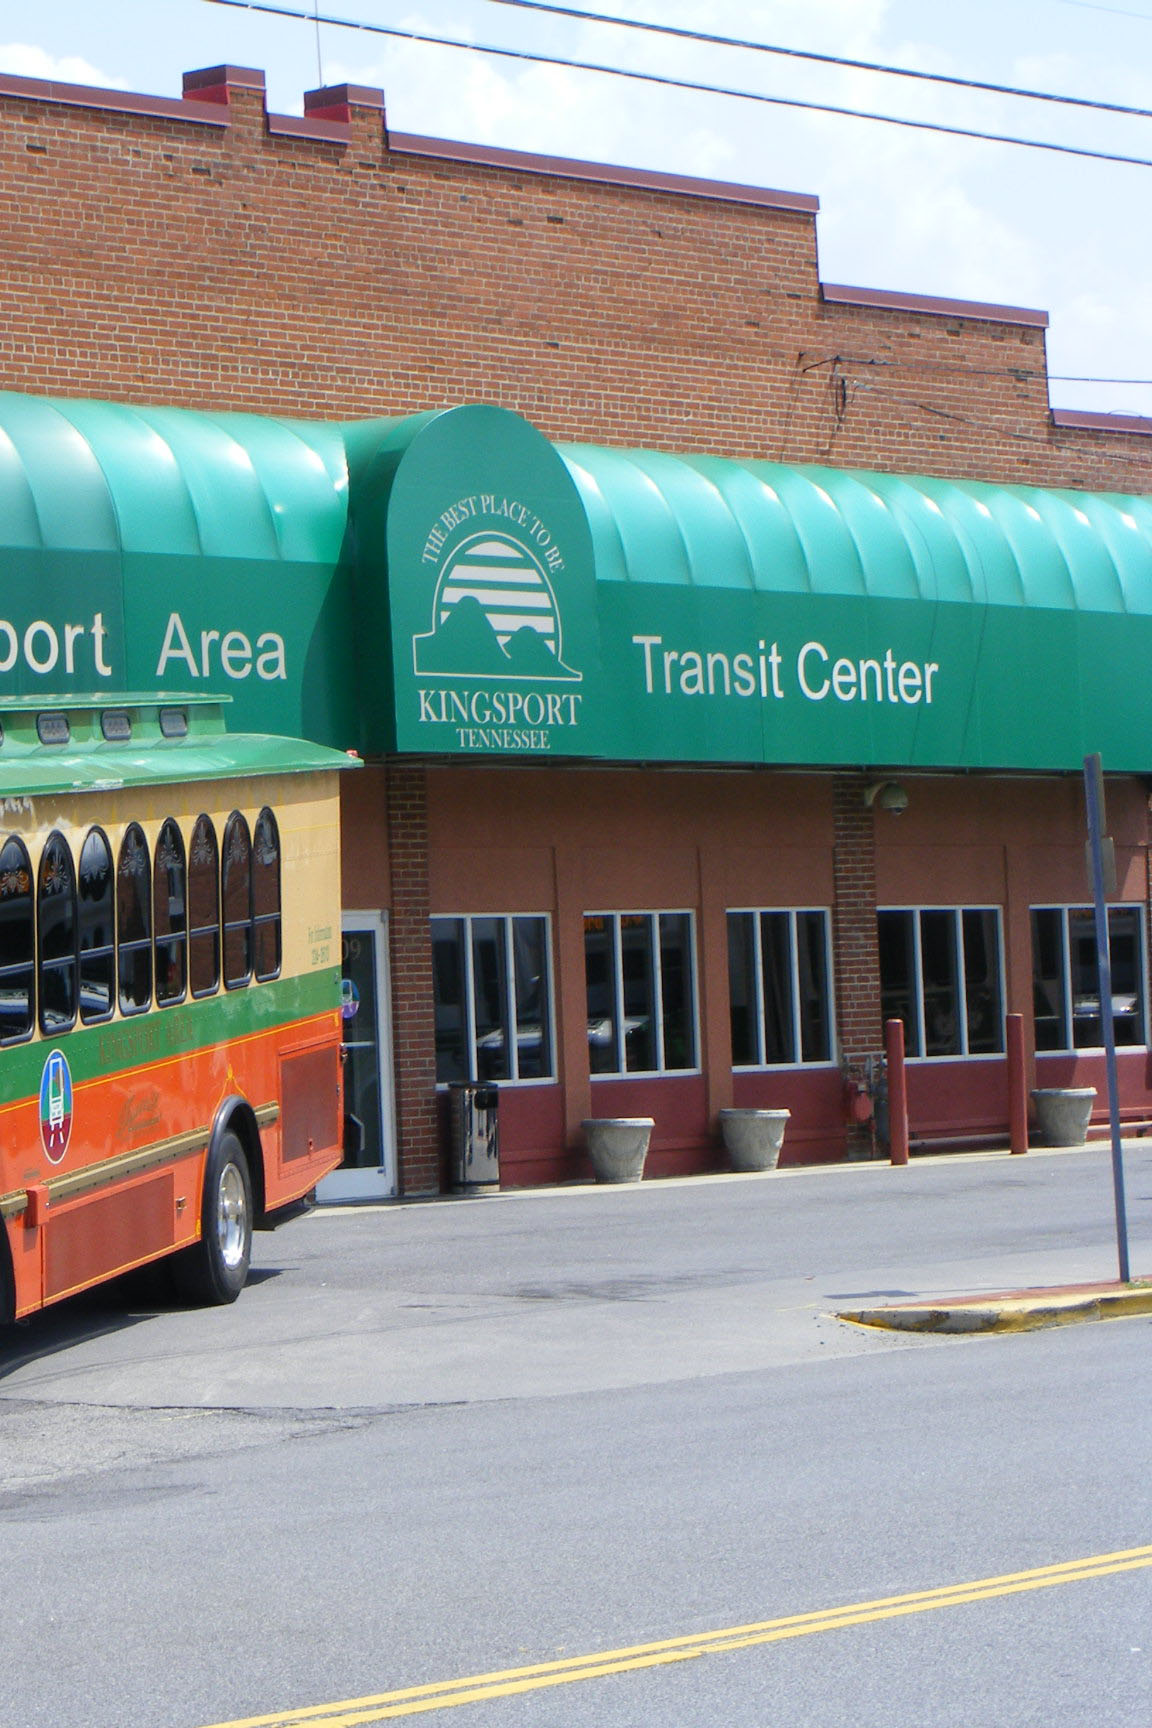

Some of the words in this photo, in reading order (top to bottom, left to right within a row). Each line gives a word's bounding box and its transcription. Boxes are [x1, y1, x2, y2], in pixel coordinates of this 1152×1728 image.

[422, 523, 448, 564] THE
[440, 495, 477, 530] BEST
[480, 494, 530, 528] PLACE
[531, 515, 550, 547] TO
[544, 545, 566, 574] BE
[155, 612, 288, 681] Area
[632, 635, 784, 698] Transit
[797, 641, 939, 703] Center
[418, 689, 583, 725] KINGSPORT
[456, 727, 551, 749] TENNESSEE
